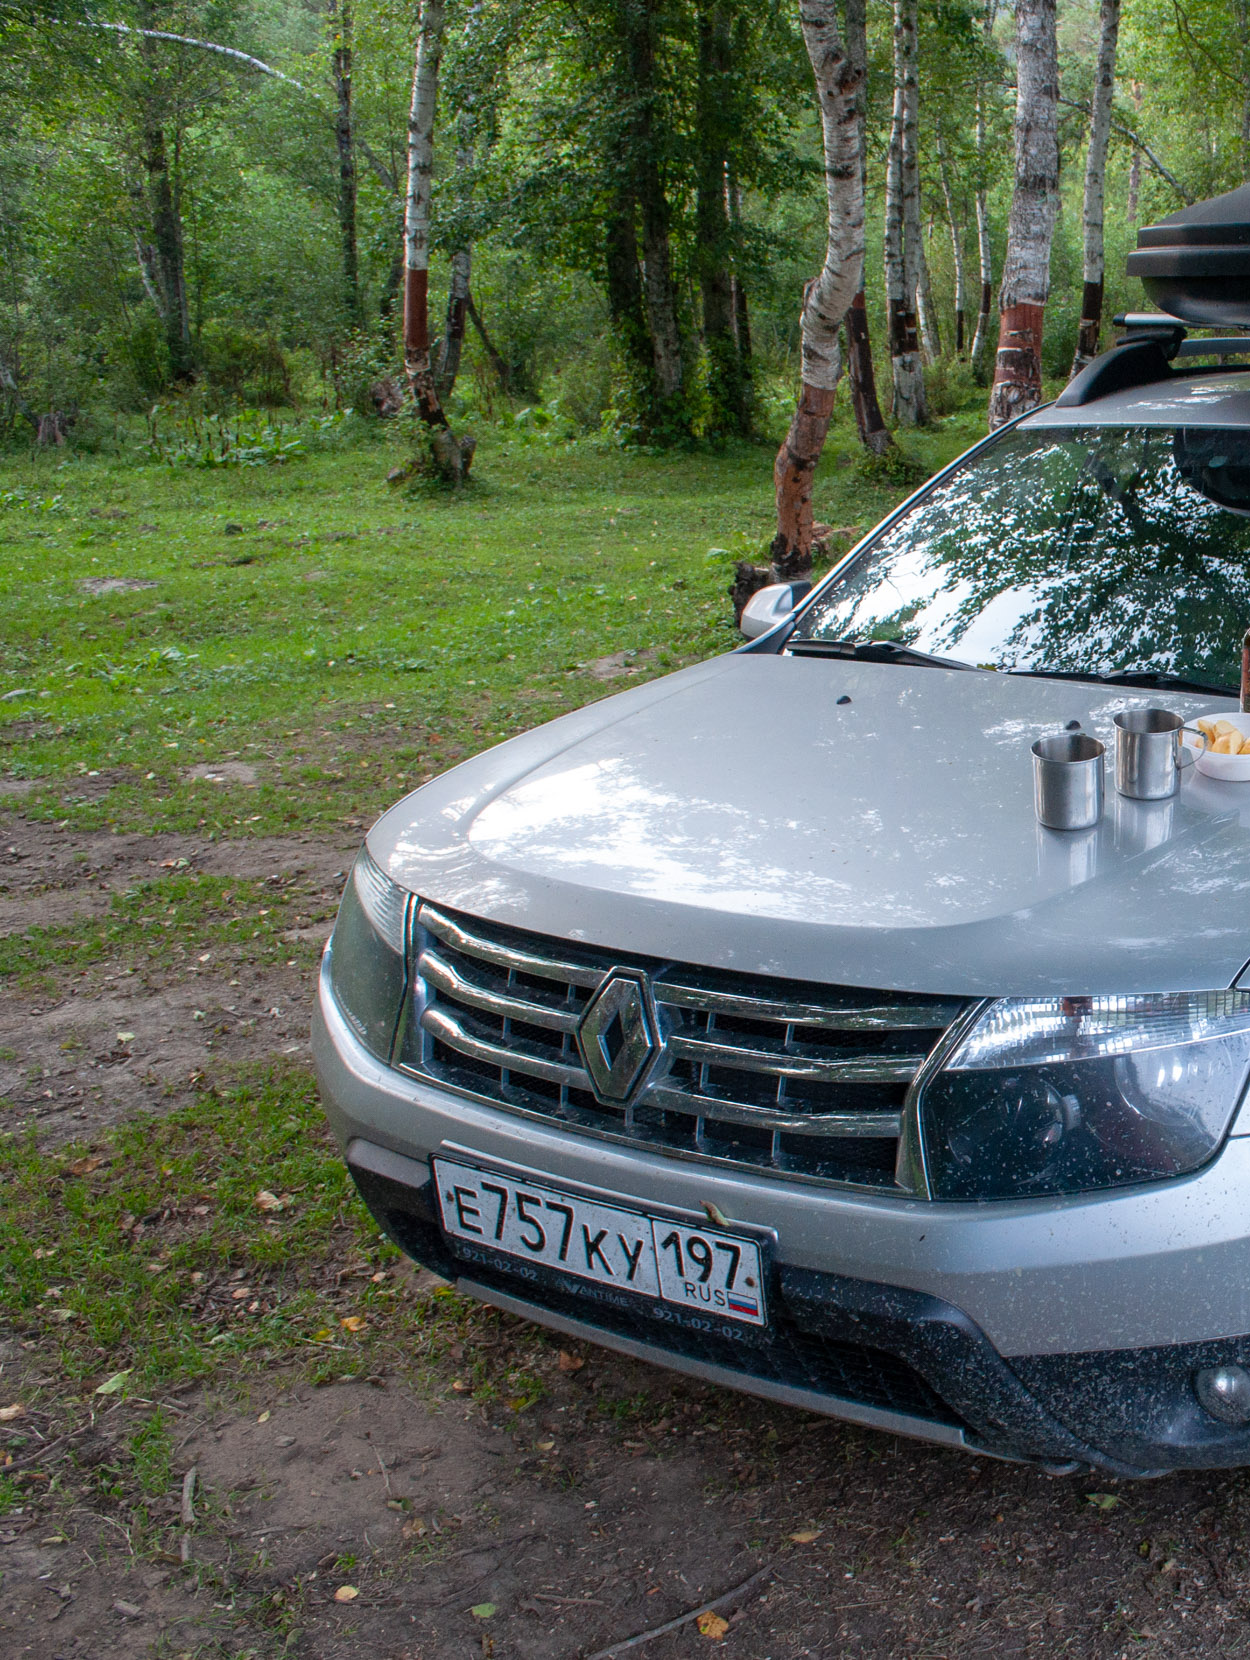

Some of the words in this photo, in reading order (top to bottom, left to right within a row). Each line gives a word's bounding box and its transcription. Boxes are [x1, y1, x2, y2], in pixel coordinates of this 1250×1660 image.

[661, 1231, 741, 1290] 197
[463, 1248, 539, 1281] 921-02-02
[653, 1306, 744, 1341] 921-02-02
[685, 1281, 726, 1306] RUS
